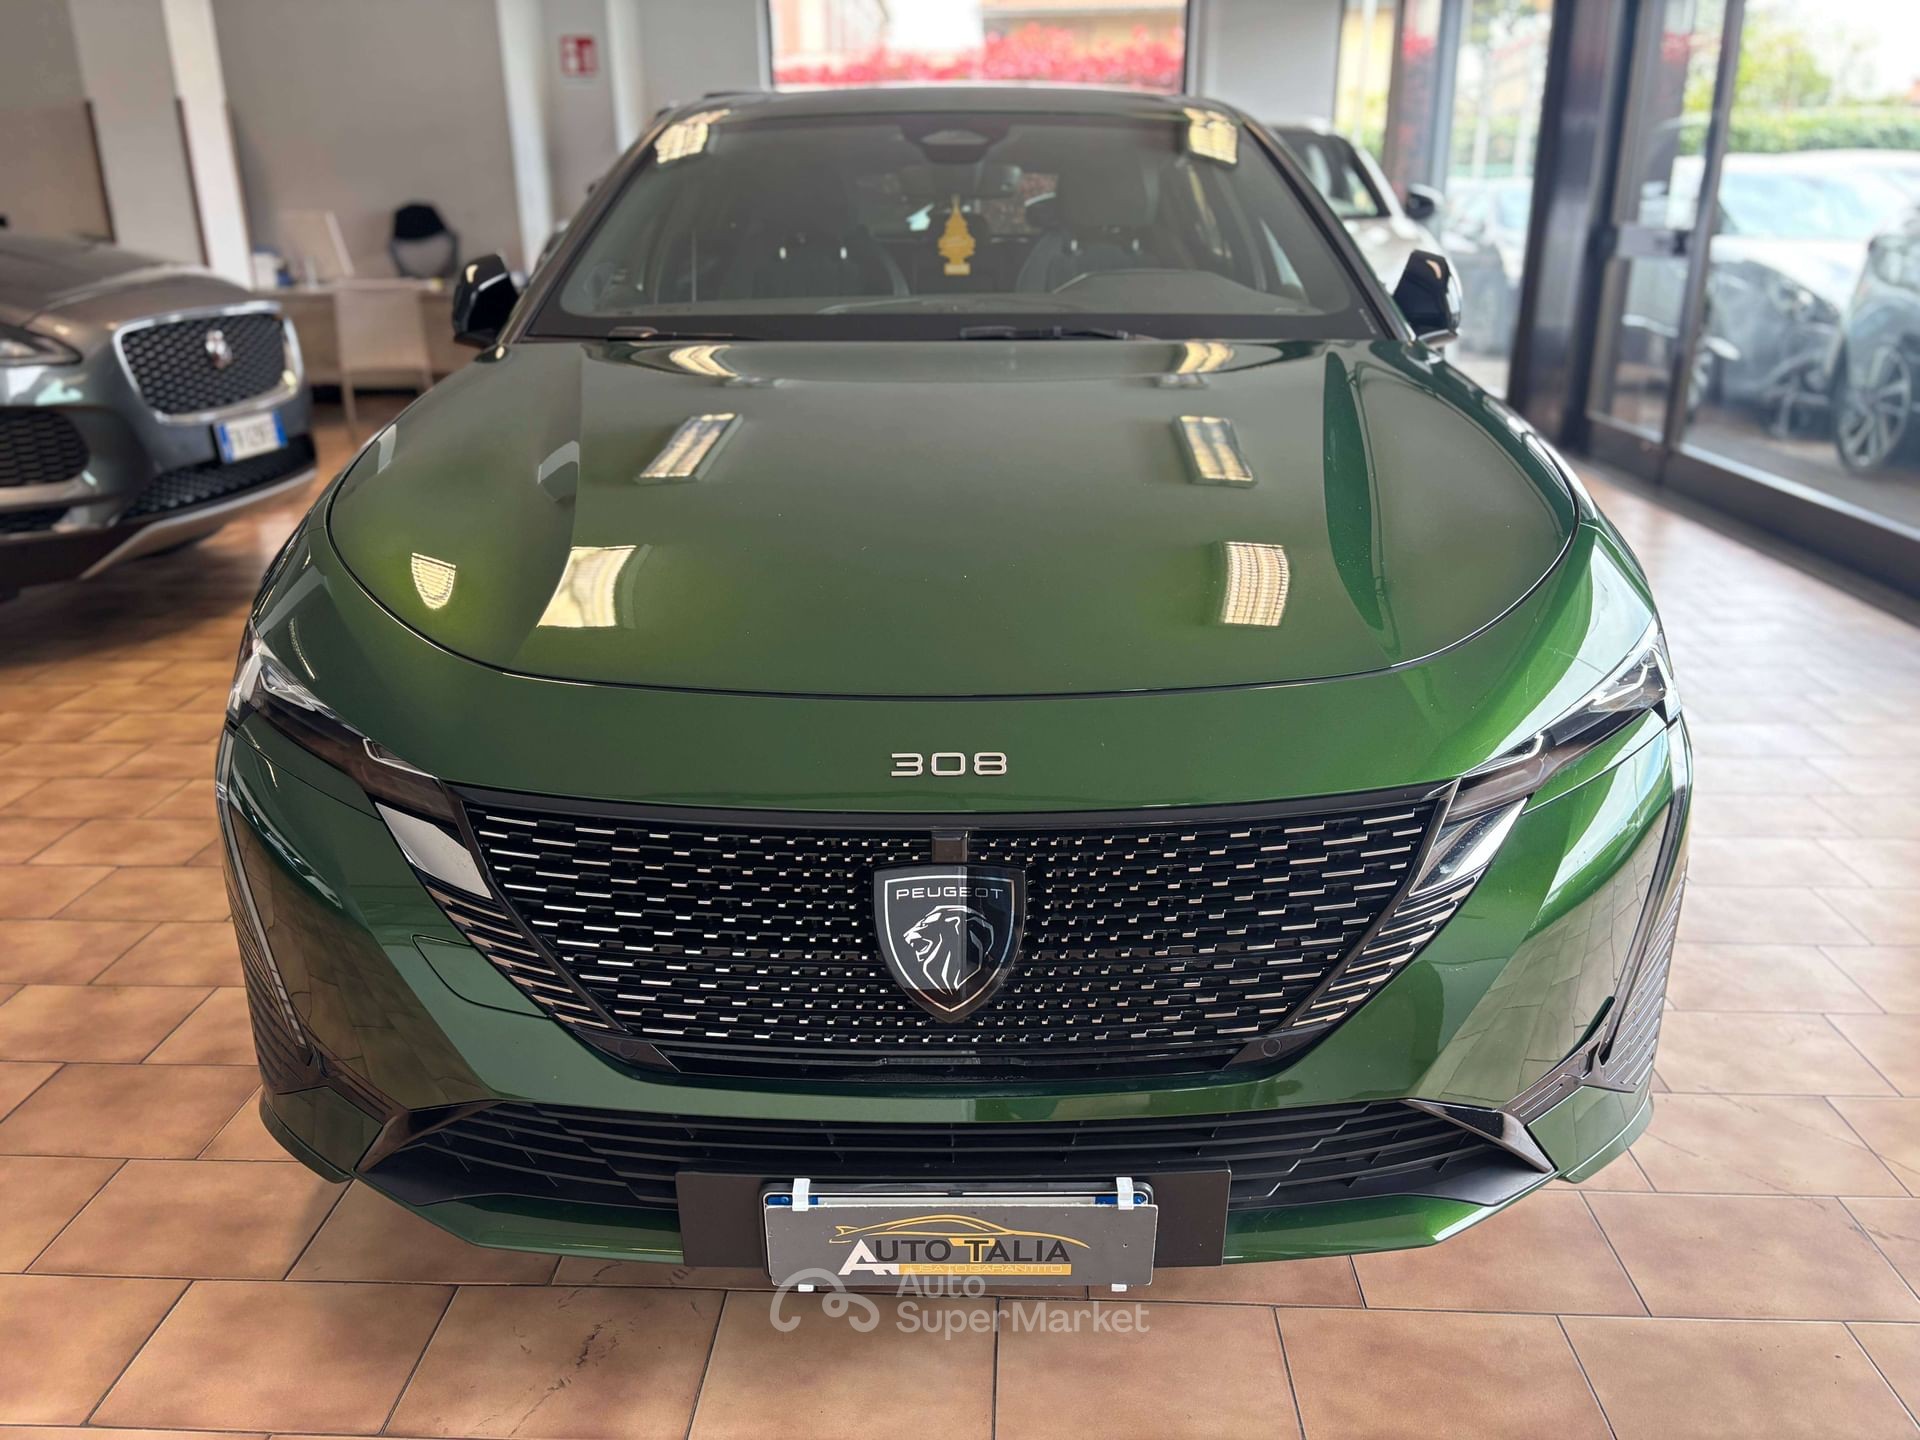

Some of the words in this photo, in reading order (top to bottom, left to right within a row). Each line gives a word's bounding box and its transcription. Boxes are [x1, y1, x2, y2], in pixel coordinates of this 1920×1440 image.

[891, 752, 1007, 777] 308
[896, 886, 1003, 900] PEUGEOT
[838, 1238, 950, 1275] AUTO
[948, 1237, 1071, 1263] TALIA
[968, 1264, 1063, 1273] GARANTITO
